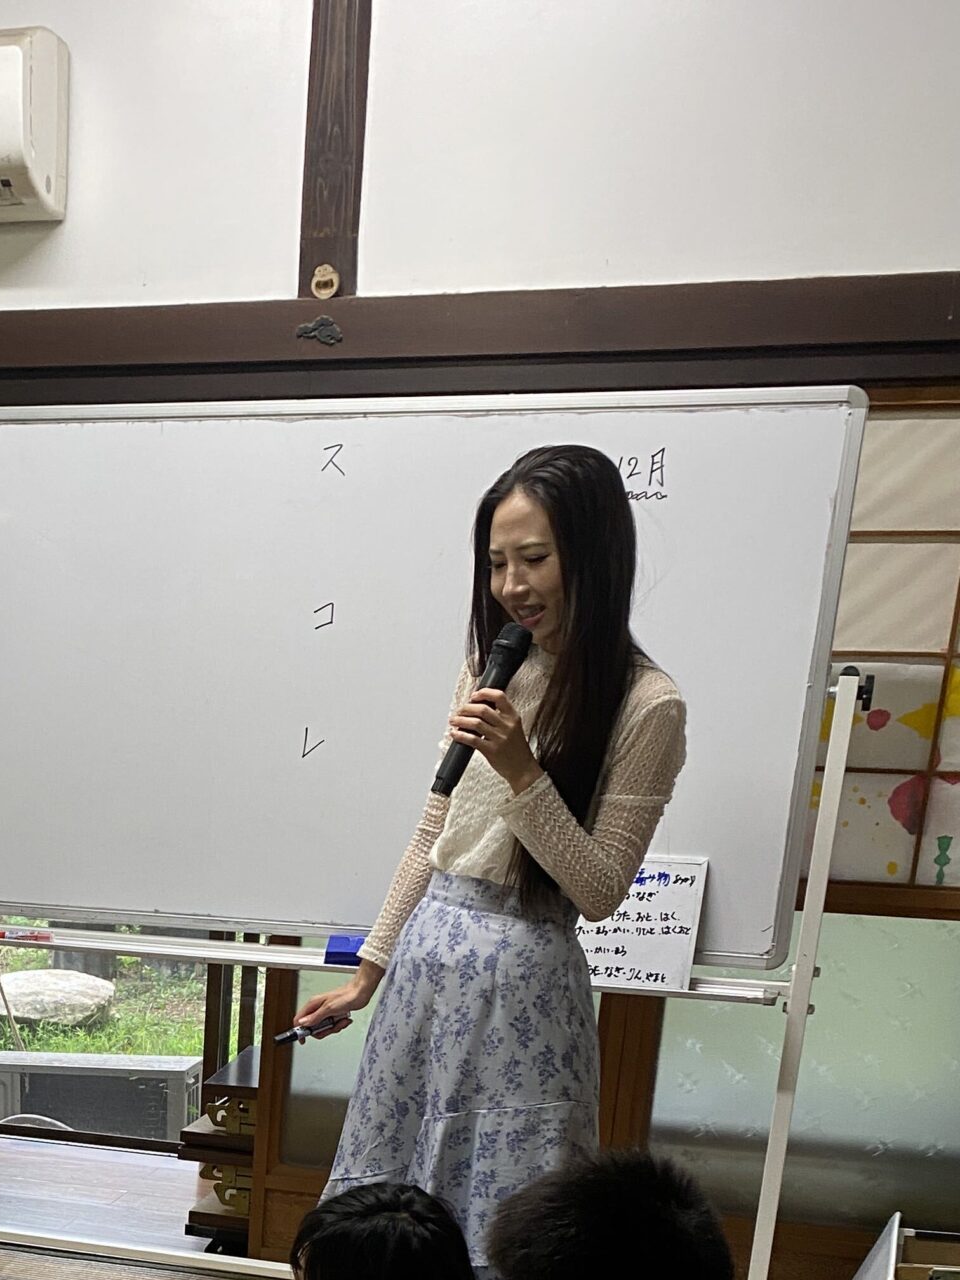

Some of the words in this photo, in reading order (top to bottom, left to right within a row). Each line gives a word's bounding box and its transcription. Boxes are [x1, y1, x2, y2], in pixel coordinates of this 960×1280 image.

[321, 443, 346, 477] ス
[617, 446, 666, 488] 12月
[313, 602, 335, 630] コ
[301, 726, 326, 759] レ
